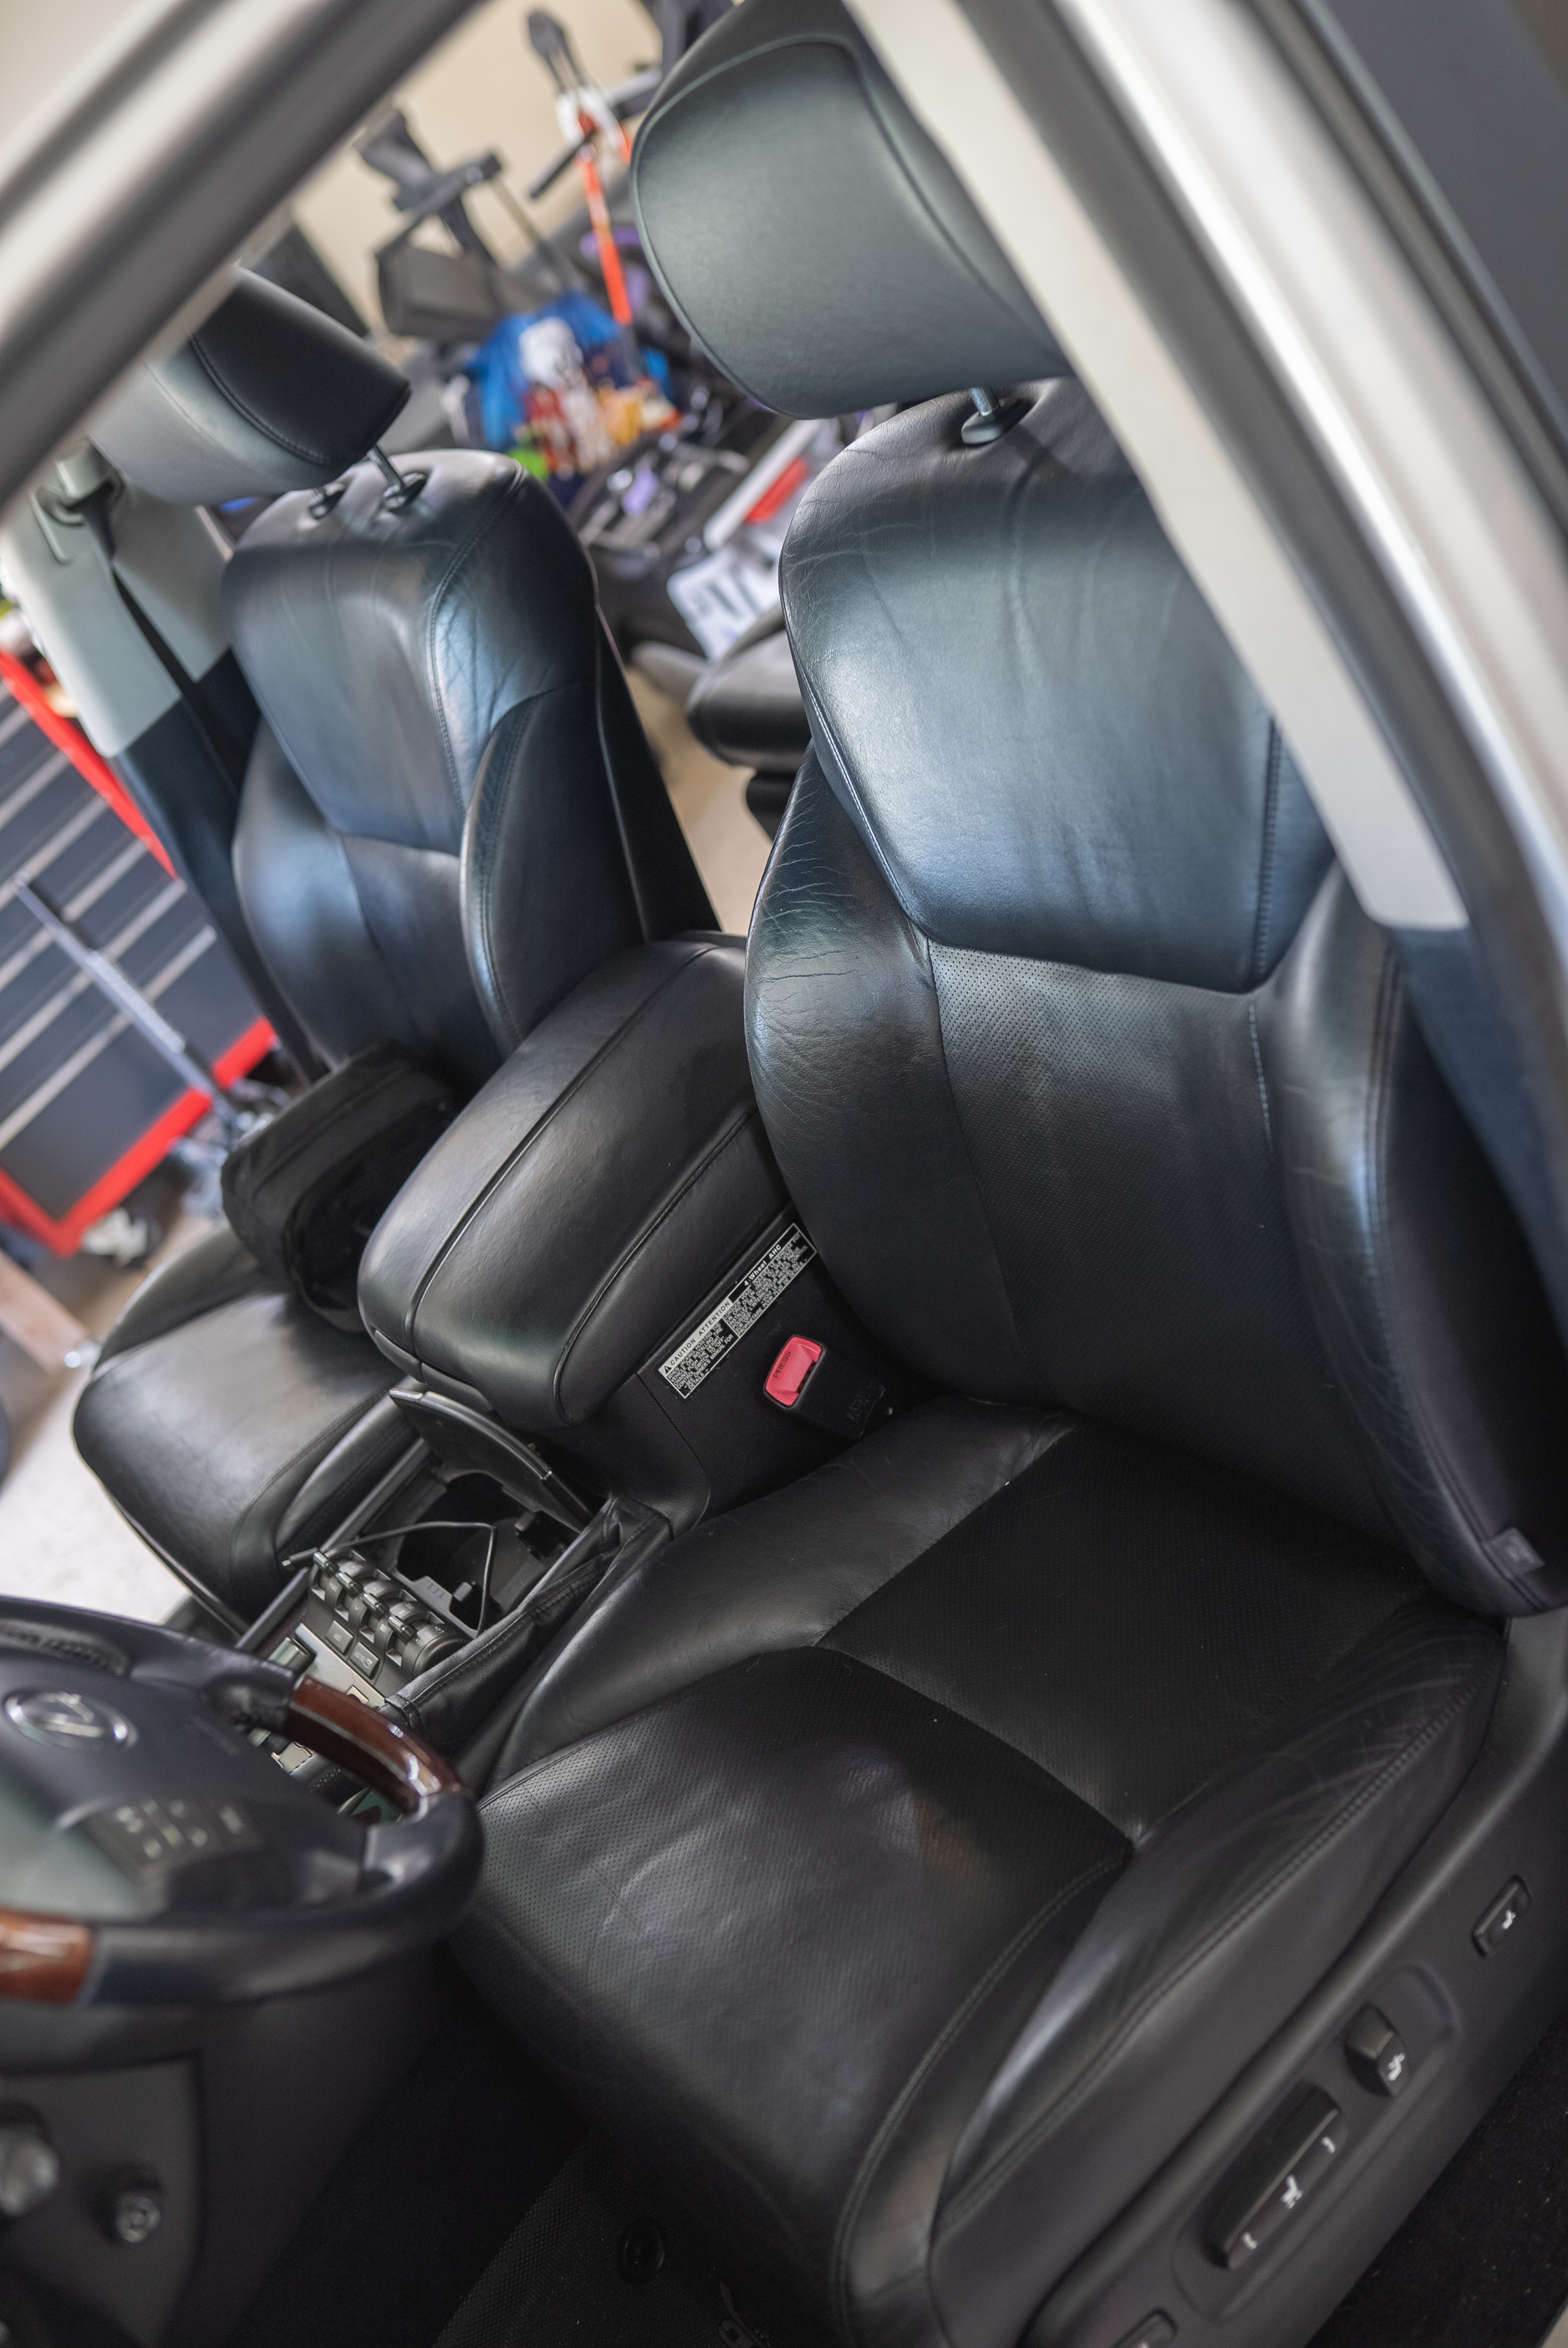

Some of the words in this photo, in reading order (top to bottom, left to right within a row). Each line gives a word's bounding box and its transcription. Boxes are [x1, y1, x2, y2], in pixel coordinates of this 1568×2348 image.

[767, 1243, 781, 1259] AHC
[729, 1304, 749, 1326] INSTALLEZ
[747, 1295, 756, 1306] DES
[771, 1268, 780, 1279] SUR
[732, 1304, 742, 1316] CRIC
[741, 1297, 749, 1306] OU
[748, 1290, 756, 1298] UN
[767, 1269, 775, 1277] OU
[773, 1259, 783, 1270] QUE
[781, 1248, 793, 1261] VOUS
[740, 1287, 752, 1300] VOUS
[750, 1266, 771, 1289] OULEVEZ
[731, 1309, 750, 1329] POUSSEZ
[762, 1294, 773, 1308] POUR
[669, 1337, 696, 1366] CAUTION
[697, 1301, 730, 1336] ATTENTION
[734, 1322, 744, 1332] SUR
[667, 1366, 679, 1380] WHEN
[694, 1330, 713, 1351] HOISTING
[711, 1321, 721, 1332] THE
[670, 1364, 687, 1383] VEHICLE
[685, 1358, 693, 1366] OR
[692, 1336, 714, 1359] INSTALLING
[713, 1325, 724, 1337] TIRE
[687, 1358, 699, 1371] PUSH
[698, 1350, 707, 1360] THE
[705, 1335, 721, 1351] HEIGHT
[693, 1358, 711, 1378] OWNER'S
[710, 1342, 725, 1360] MANUAL
[724, 1333, 734, 1344] FOR
[773, 1351, 791, 1378] PRESS
[676, 1369, 695, 1390] CONTROL
[694, 1353, 710, 1370] SWITCH
[688, 1372, 704, 1390] DETAILS
